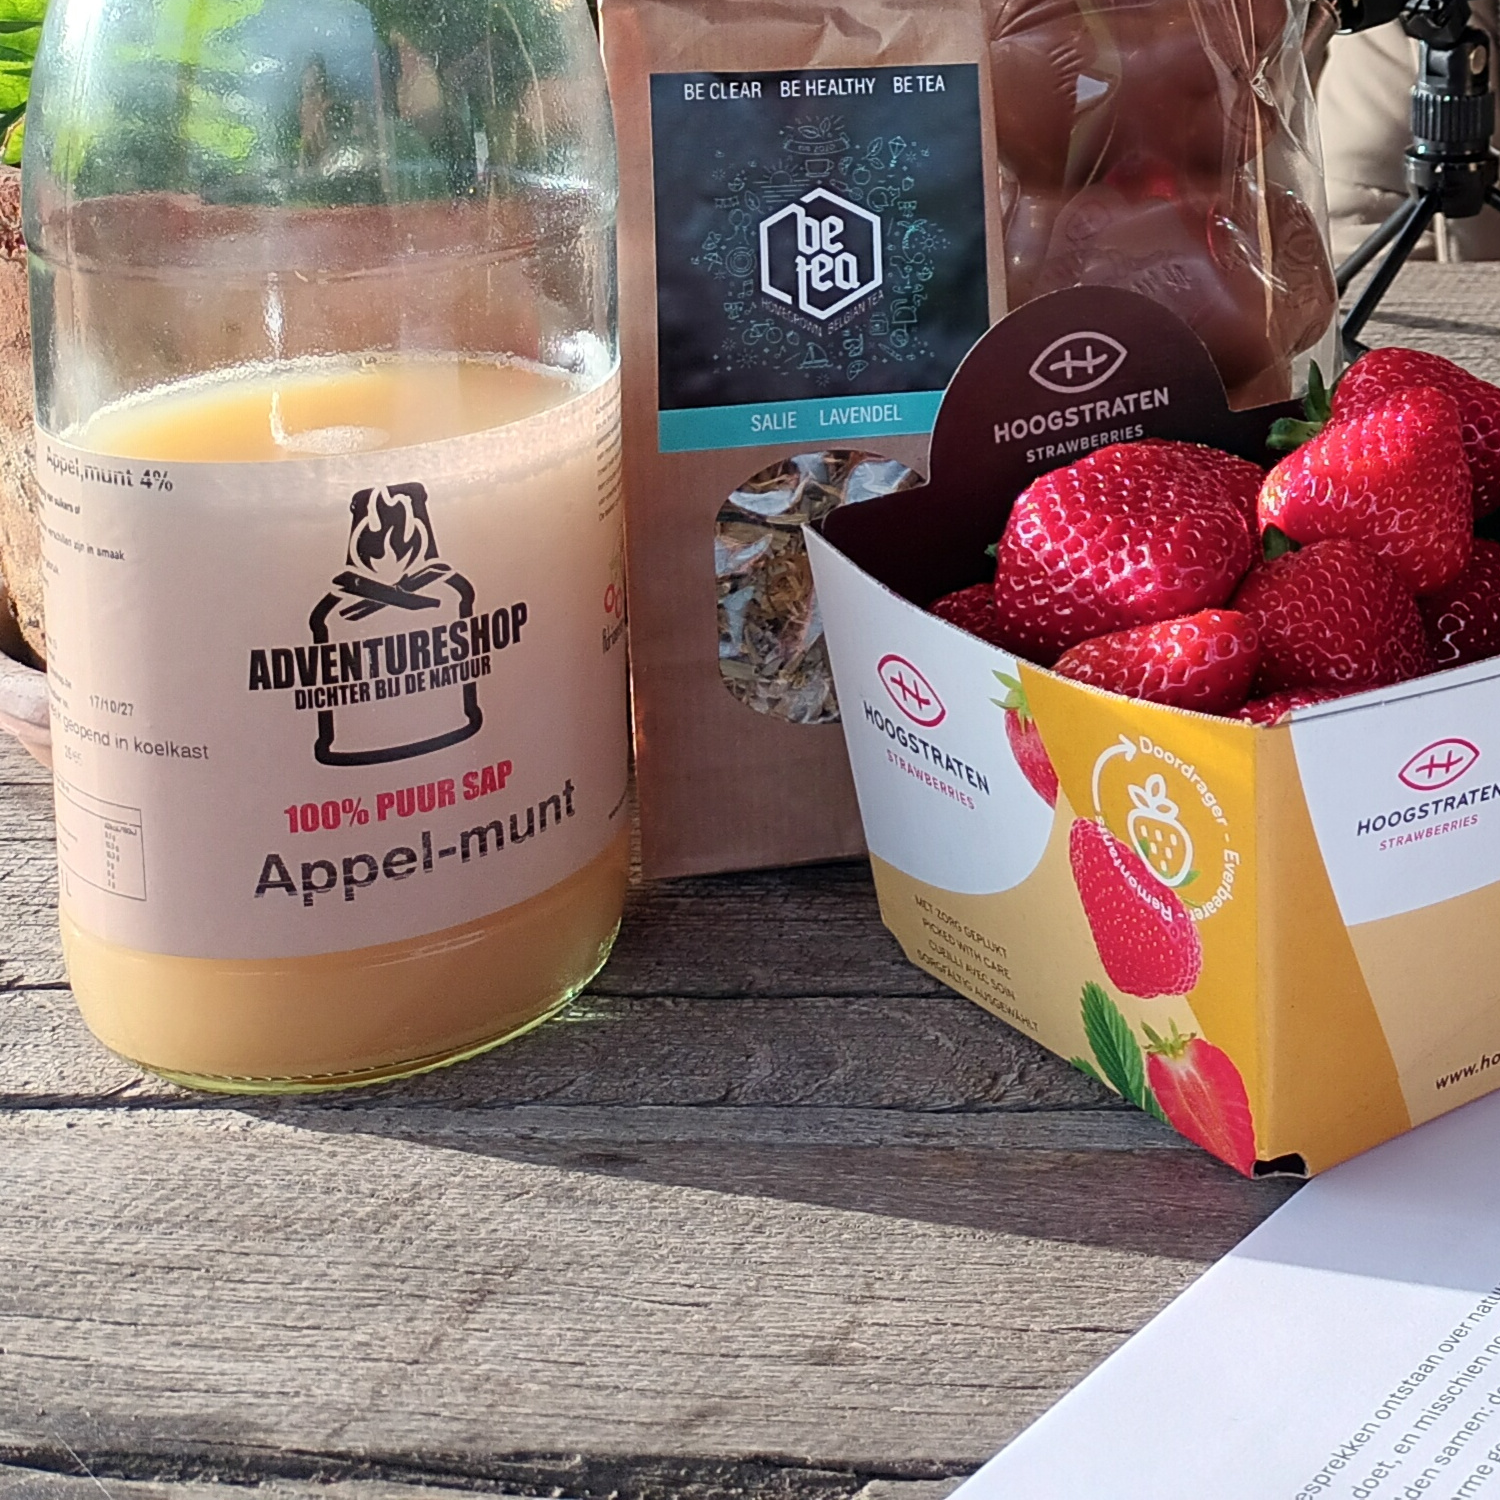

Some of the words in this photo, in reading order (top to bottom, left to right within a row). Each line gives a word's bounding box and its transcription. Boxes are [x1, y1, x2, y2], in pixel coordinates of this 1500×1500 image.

[684, 83, 705, 101] BE
[709, 81, 762, 100] CLEAR
[780, 80, 801, 98] BE
[805, 77, 876, 97] HEALTHY
[893, 76, 914, 94] BE
[916, 75, 946, 93] TEA
[798, 212, 844, 255] be
[795, 252, 861, 293] tea
[827, 302, 866, 336] BELGIAN
[867, 290, 885, 311] TEA
[751, 411, 798, 433] SALIE
[819, 404, 903, 427] LAVENDEL
[993, 387, 1170, 444] HOOGSTRATEN
[1026, 424, 1144, 463] STRAWBERRIES
[140, 468, 174, 492] 4%
[97, 544, 126, 561] smaak
[248, 602, 529, 692] ADVENTURESHOP
[294, 683, 371, 711] DICHTER
[374, 675, 402, 700] BIJ
[404, 672, 427, 696] DE
[429, 655, 492, 690] NATUUR
[115, 734, 128, 752] in
[134, 737, 209, 760] koelkast
[862, 700, 990, 795] HOOGSTRATEN
[284, 797, 370, 834] 100%
[376, 778, 457, 822] PUUR
[463, 760, 513, 803] SAP
[886, 748, 976, 810] STRAWBERRIES
[253, 779, 578, 908] Appel-munt
[1139, 735, 1228, 827] Doordrager
[1189, 848, 1240, 922] Everbearer
[1379, 815, 1478, 851] STRAWBERRIES
[914, 894, 933, 914] MET
[936, 908, 962, 932] ZORG
[964, 926, 1007, 959] GEPLUKT
[922, 917, 955, 945] PICKED
[956, 940, 982, 963] WITH
[984, 956, 1012, 980] CARE
[965, 963, 989, 986] AVEC
[990, 977, 1016, 1001] SOIN
[1295, 1423, 1381, 1500] esprekken
[1375, 1355, 1444, 1419] ontstaan
[1438, 1322, 1472, 1352] over
[1351, 1460, 1402, 1500] doet,
[1394, 1434, 1421, 1455] en
[1413, 1356, 1493, 1431] misschien
[1394, 1468, 1441, 1500] den
[1434, 1407, 1494, 1465] samen:
[1451, 1465, 1494, 1500] rme
